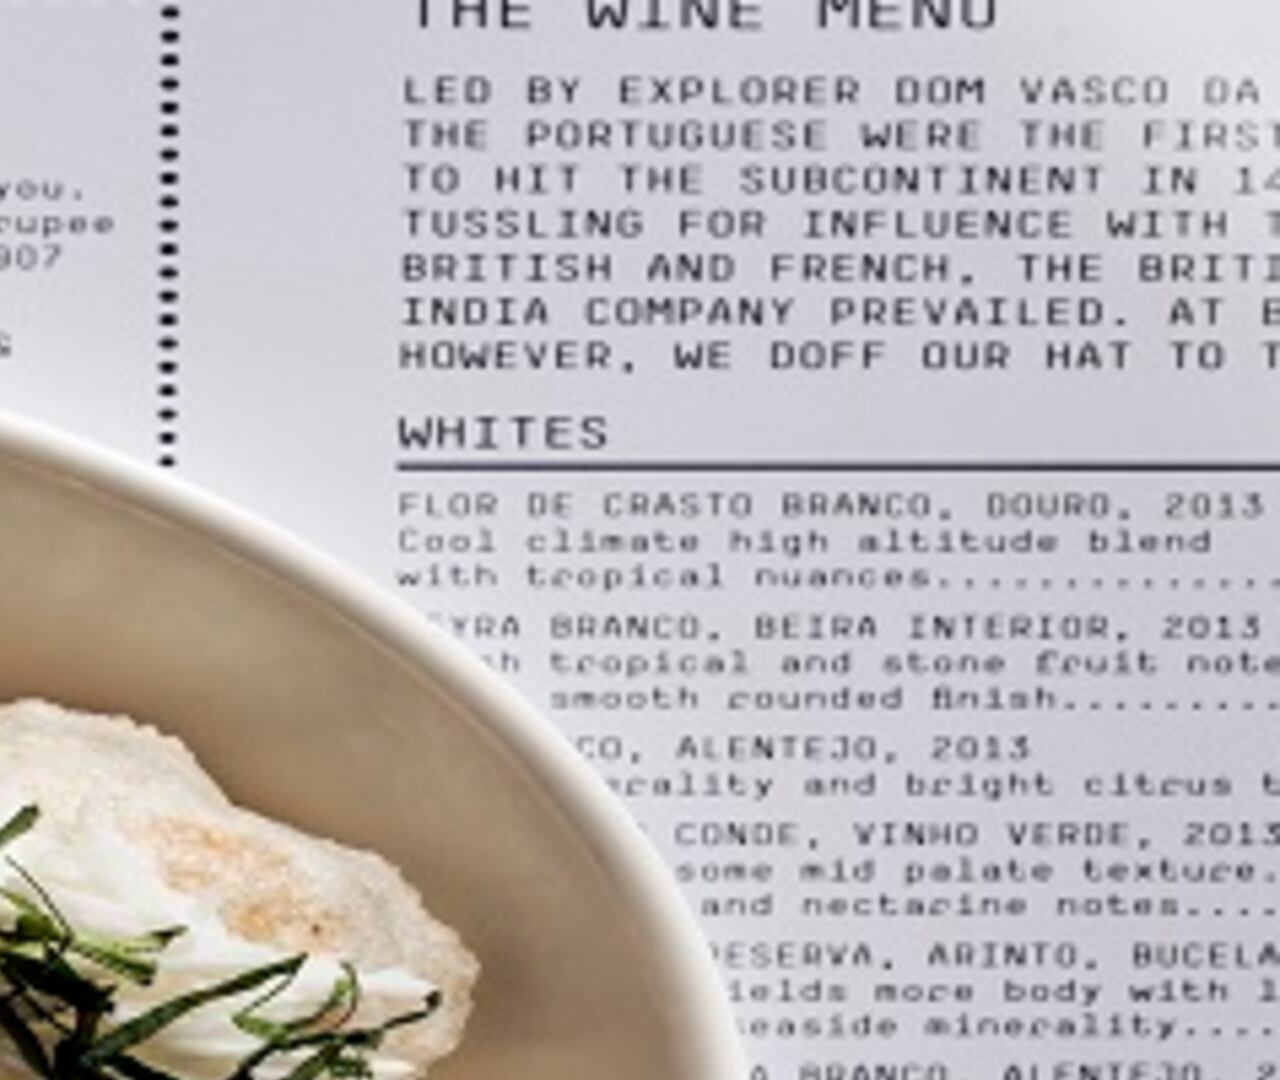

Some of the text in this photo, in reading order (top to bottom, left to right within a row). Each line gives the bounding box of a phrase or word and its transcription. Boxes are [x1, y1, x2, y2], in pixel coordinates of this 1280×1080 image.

[418, 0, 997, 32] THE WINE MENU
[403, 74, 1261, 106] LED BY EXPLORER DOM VASCO DA
[404, 118, 1102, 152] THE PORTUGUESE WERE THE
[406, 163, 1197, 197] TO HIT THE SUBCONTINENT IN
[406, 208, 1228, 240] TUSSLING FOR INFLUENCE WITH
[401, 251, 613, 284] BRITISH
[646, 252, 736, 284] AND
[1018, 252, 1100, 284] THE
[403, 295, 1223, 328] INDIA COMPANY PREVAILED. AT
[672, 339, 731, 371] WE
[769, 339, 884, 371] DOFF
[920, 339, 1012, 371] OUR
[1045, 339, 1131, 371] HAT
[1170, 339, 1226, 371] TO
[396, 414, 608, 452] WHITES
[397, 490, 500, 519] FLOR
[526, 490, 571, 519] DE
[602, 490, 754, 520] CRASTO
[1164, 491, 1265, 520] 2013
[397, 526, 1213, 558] Cool climate high altitude blend
[852, 820, 980, 847] VINHO
